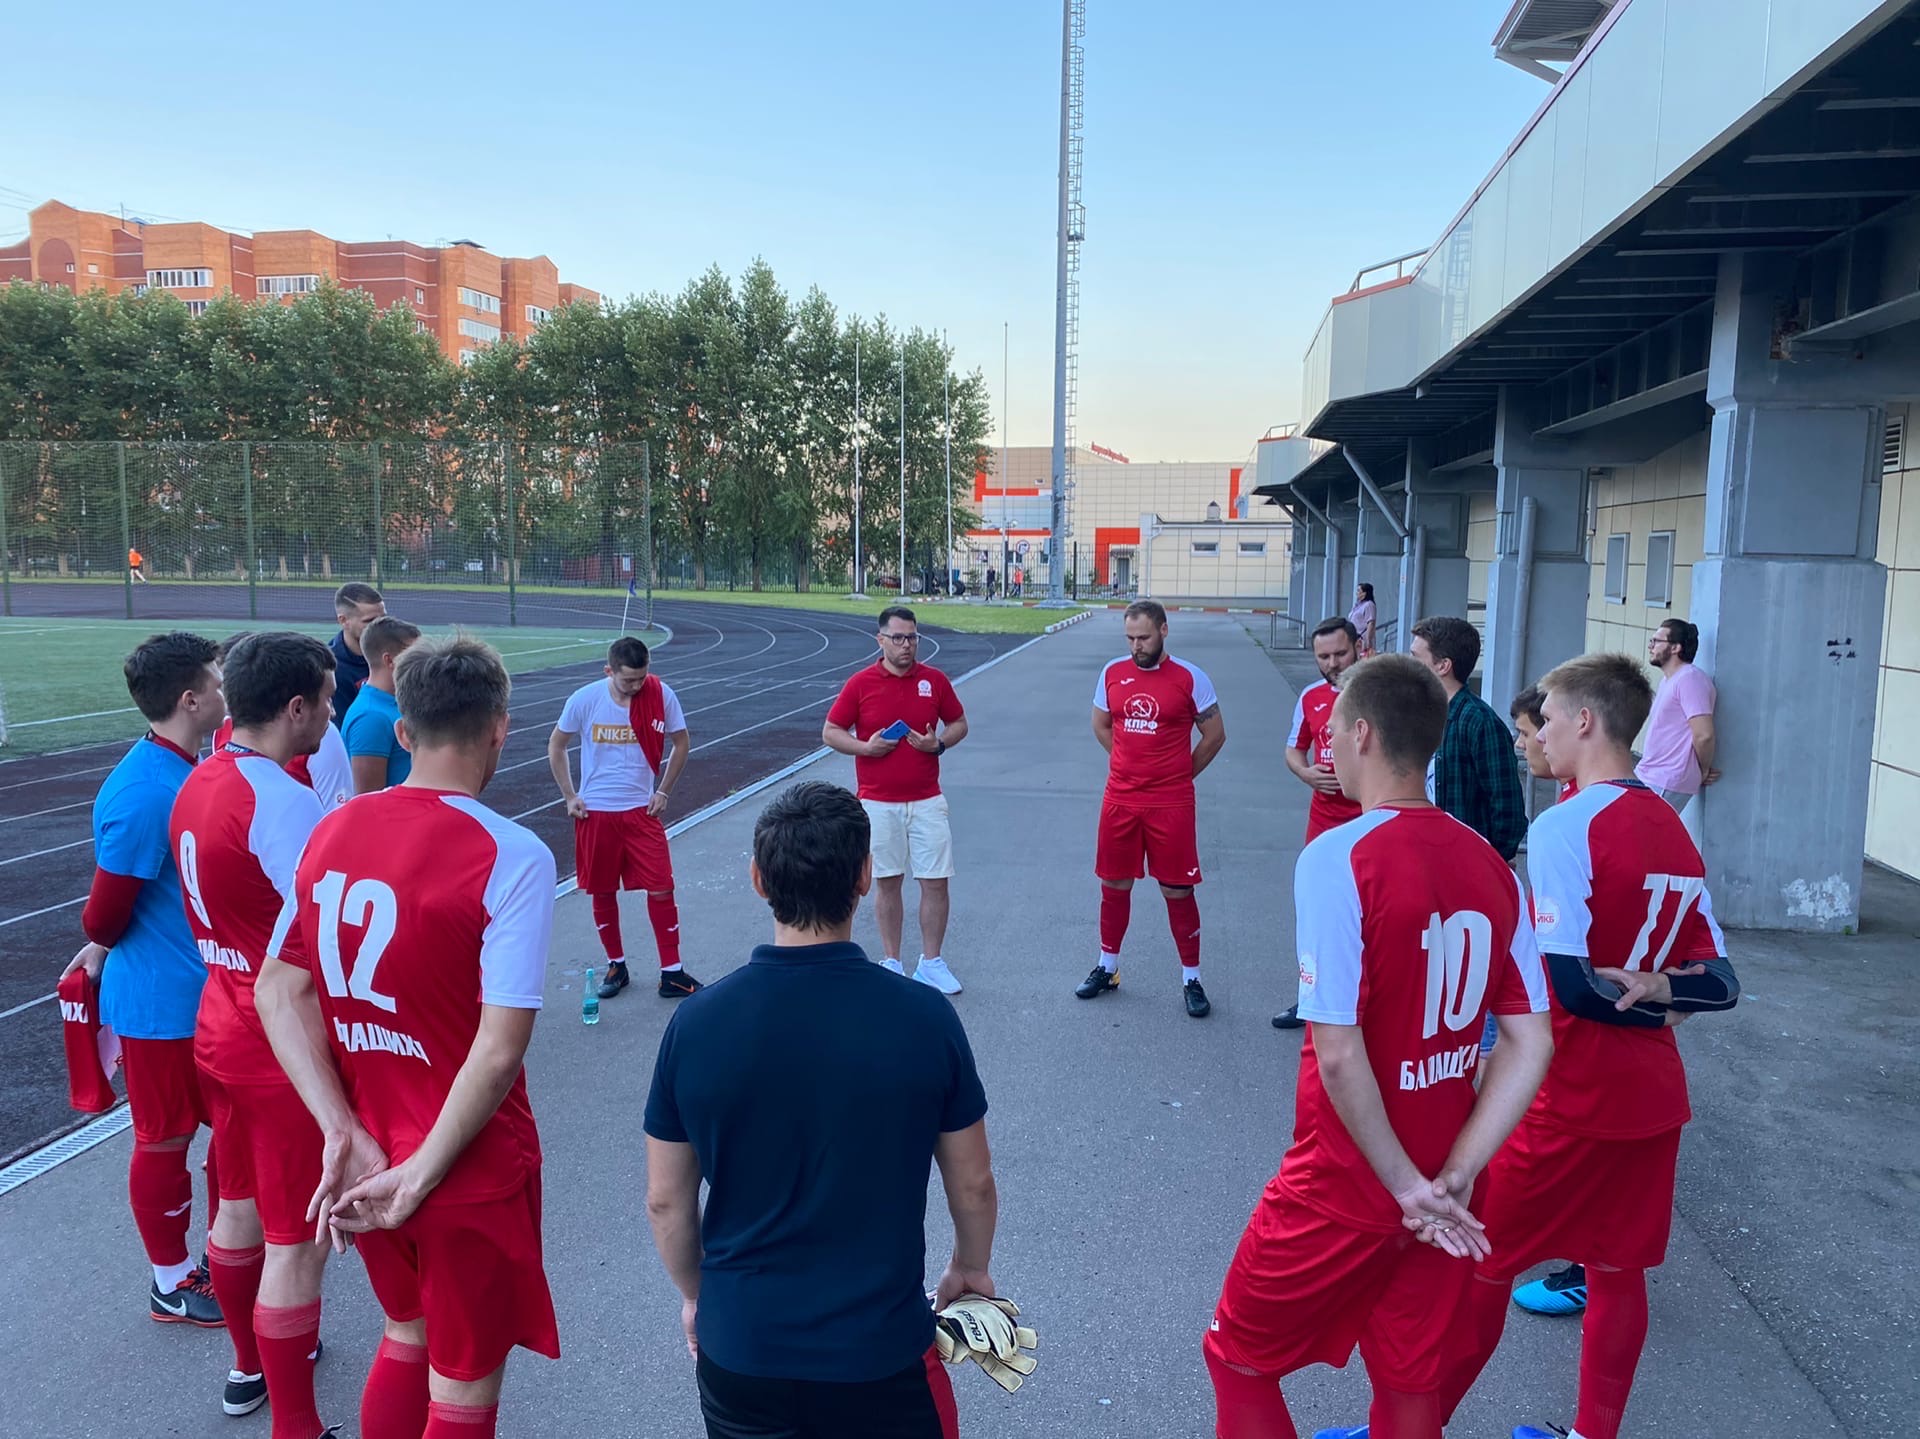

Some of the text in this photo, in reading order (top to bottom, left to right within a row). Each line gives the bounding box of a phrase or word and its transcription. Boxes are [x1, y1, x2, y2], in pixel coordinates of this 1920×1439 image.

[597, 727, 628, 740] NIKE
[1124, 718, 1158, 730] КПРФ
[180, 830, 213, 930] 9
[312, 869, 398, 1014] 12
[1421, 910, 1492, 1040] 10
